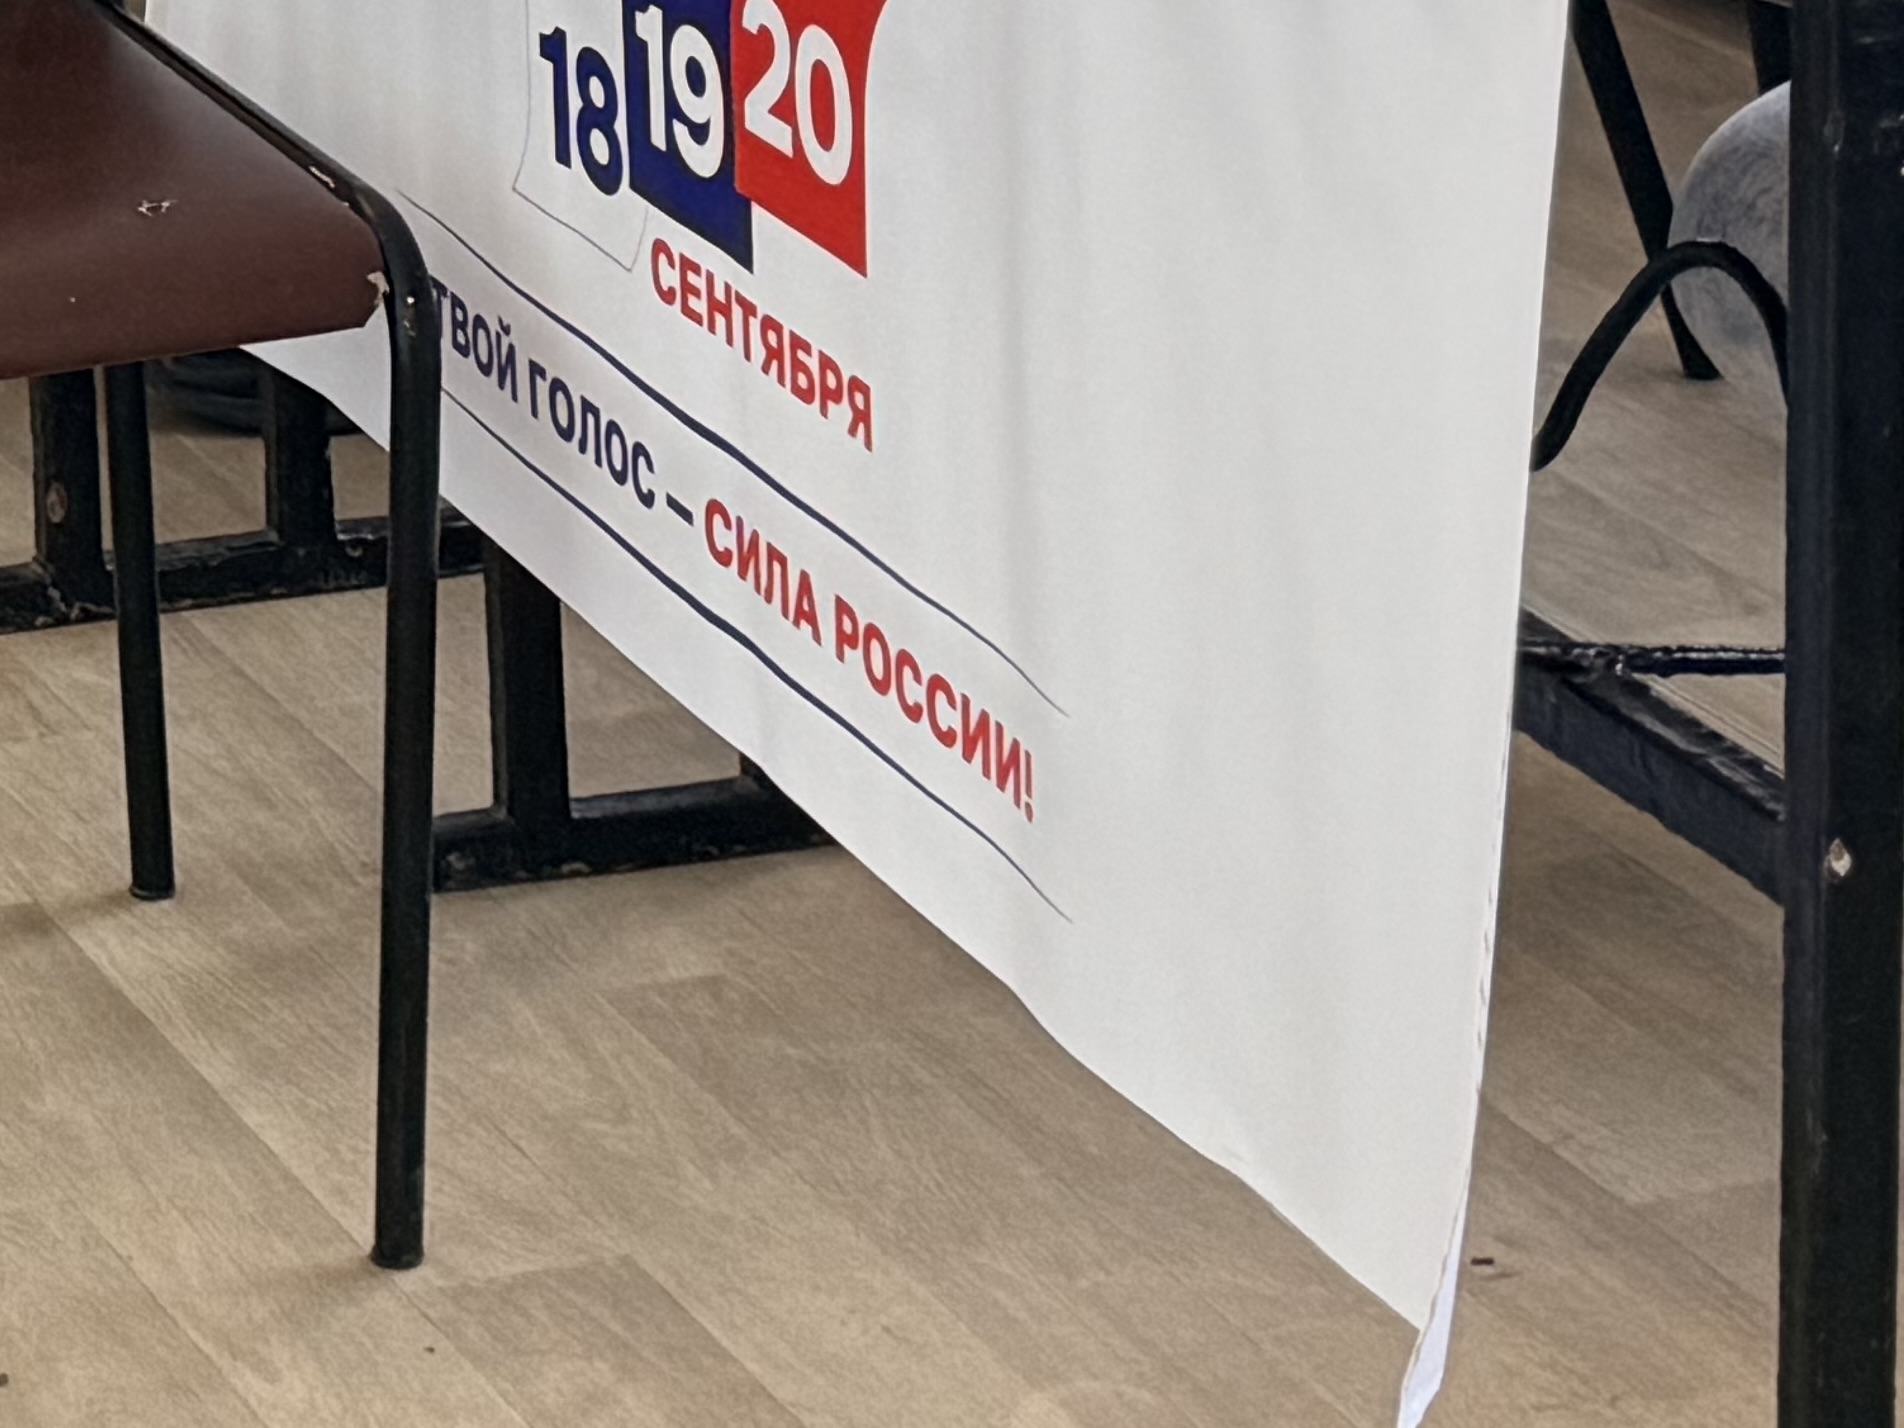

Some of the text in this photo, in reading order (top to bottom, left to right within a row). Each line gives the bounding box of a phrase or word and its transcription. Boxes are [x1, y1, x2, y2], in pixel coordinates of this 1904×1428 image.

[539, 25, 624, 197] 18
[635, 3, 725, 180] 19
[650, 238, 874, 453] СЕНТЯБРЯ
[528, 357, 656, 510] ГОЛОС
[703, 497, 823, 648] СИЛА
[834, 592, 1036, 825] РОССИИ!
